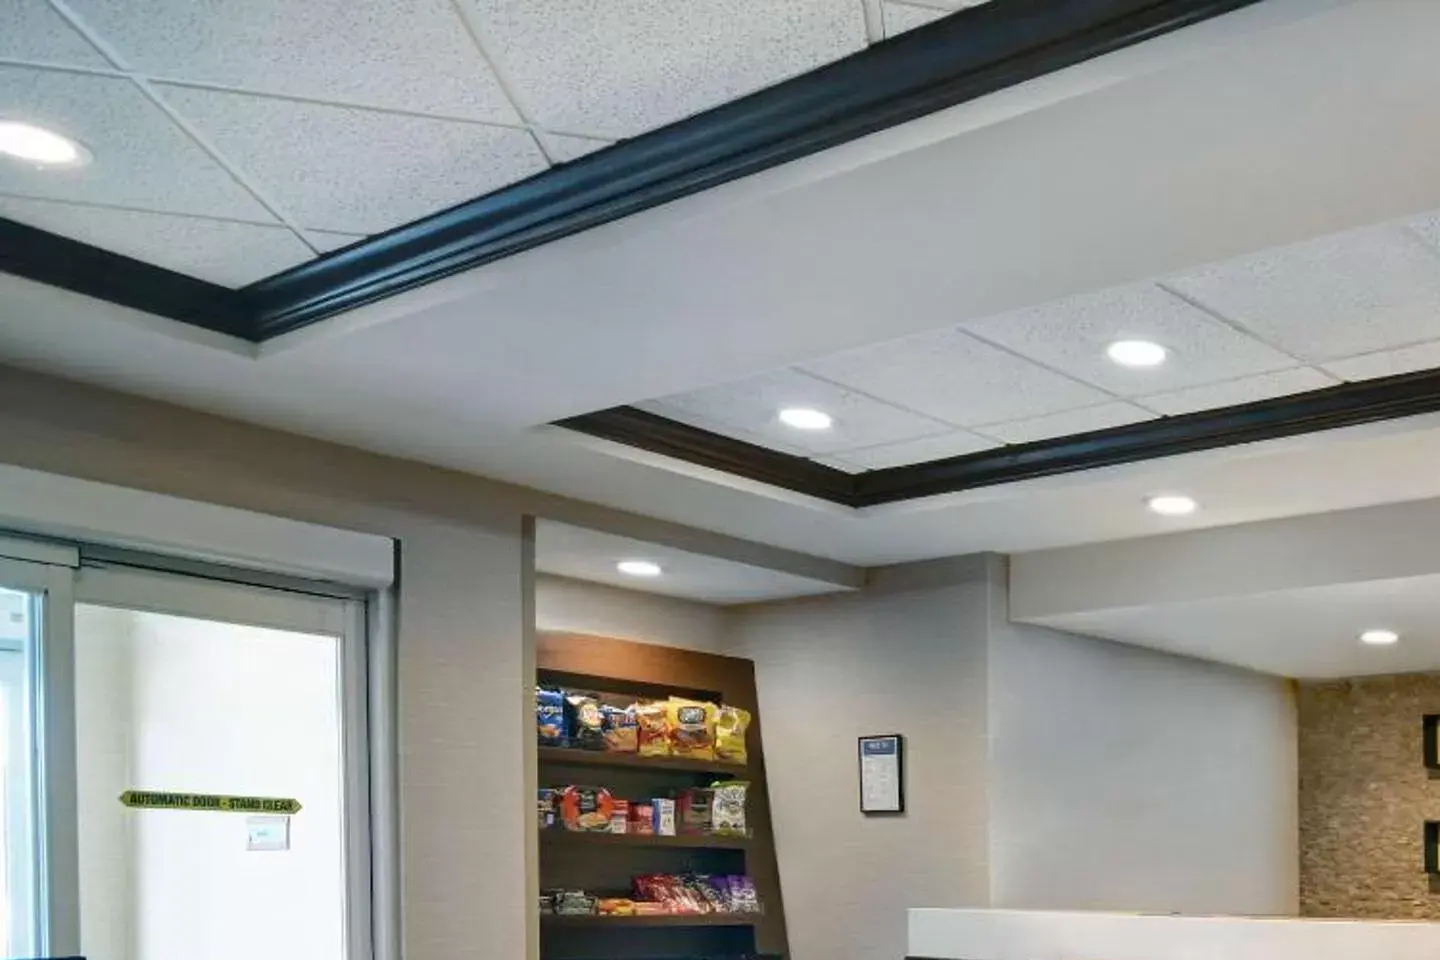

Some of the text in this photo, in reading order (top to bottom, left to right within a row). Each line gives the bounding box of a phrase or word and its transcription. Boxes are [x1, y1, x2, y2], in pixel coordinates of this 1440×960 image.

[129, 793, 191, 806] AUTOMATIC
[192, 795, 220, 808] DOOR
[229, 796, 261, 809] STAND
[262, 798, 293, 811] CLEAR
